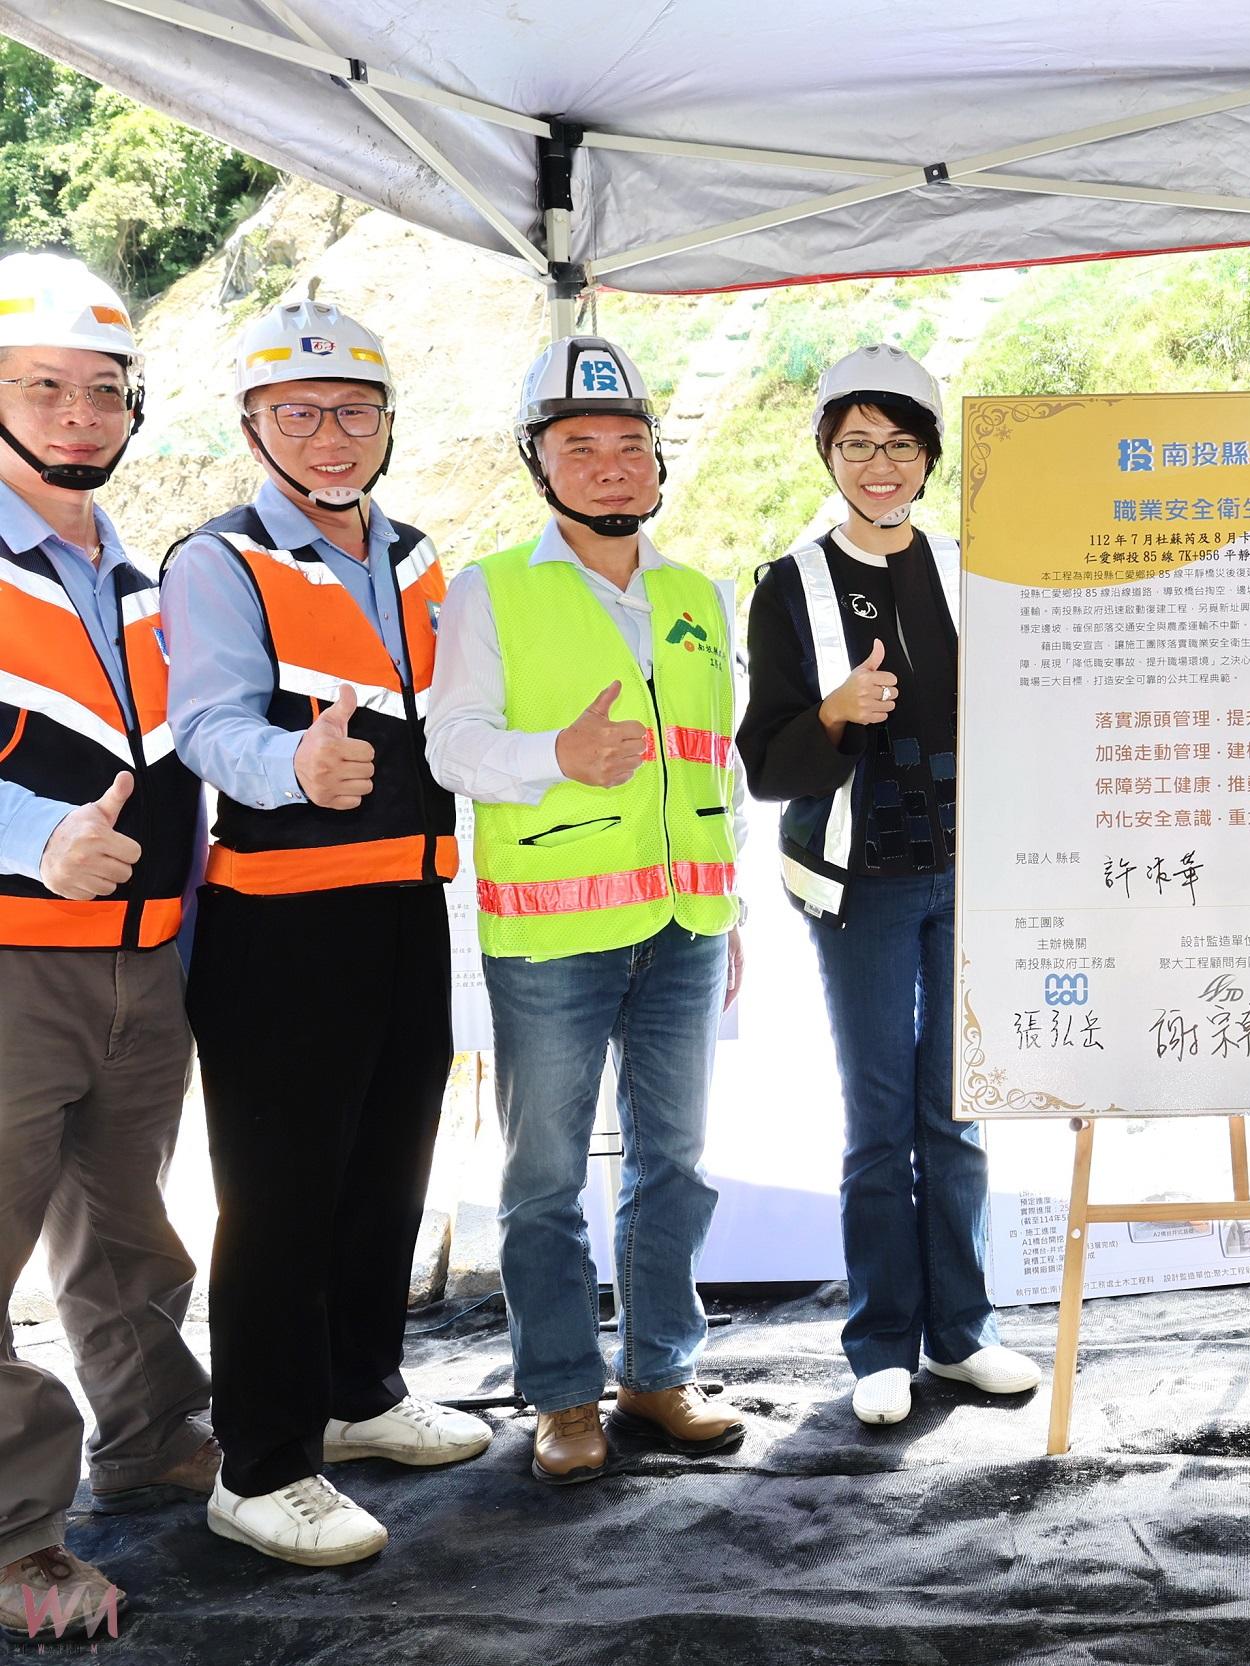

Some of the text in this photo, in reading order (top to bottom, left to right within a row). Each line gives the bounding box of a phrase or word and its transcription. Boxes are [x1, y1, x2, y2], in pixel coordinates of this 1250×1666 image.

[580, 360, 618, 391] 投
[1089, 534, 1110, 546] 112
[1114, 533, 1128, 546] 年
[1131, 533, 1138, 546] 7
[1142, 532, 1211, 546] 月杜蘇芮及
[1214, 532, 1222, 544] 8
[1084, 551, 1140, 564] 仁愛鄉投
[1143, 551, 1157, 563] 85
[1161, 550, 1175, 563] 線
[1178, 549, 1220, 562] 7K+956
[1041, 569, 1156, 581] 本工程為南投縣仁愛鄉投
[1158, 569, 1171, 579] 85
[1020, 587, 1083, 599] 投縣仁愛鄉投
[1085, 588, 1098, 598] 85
[1015, 851, 1081, 865] 見證人 縣長
[1015, 916, 1065, 929] 施工團隊
[1037, 937, 1087, 951] 主辦機關
[1015, 957, 1116, 971] 南投縣政府工務處
